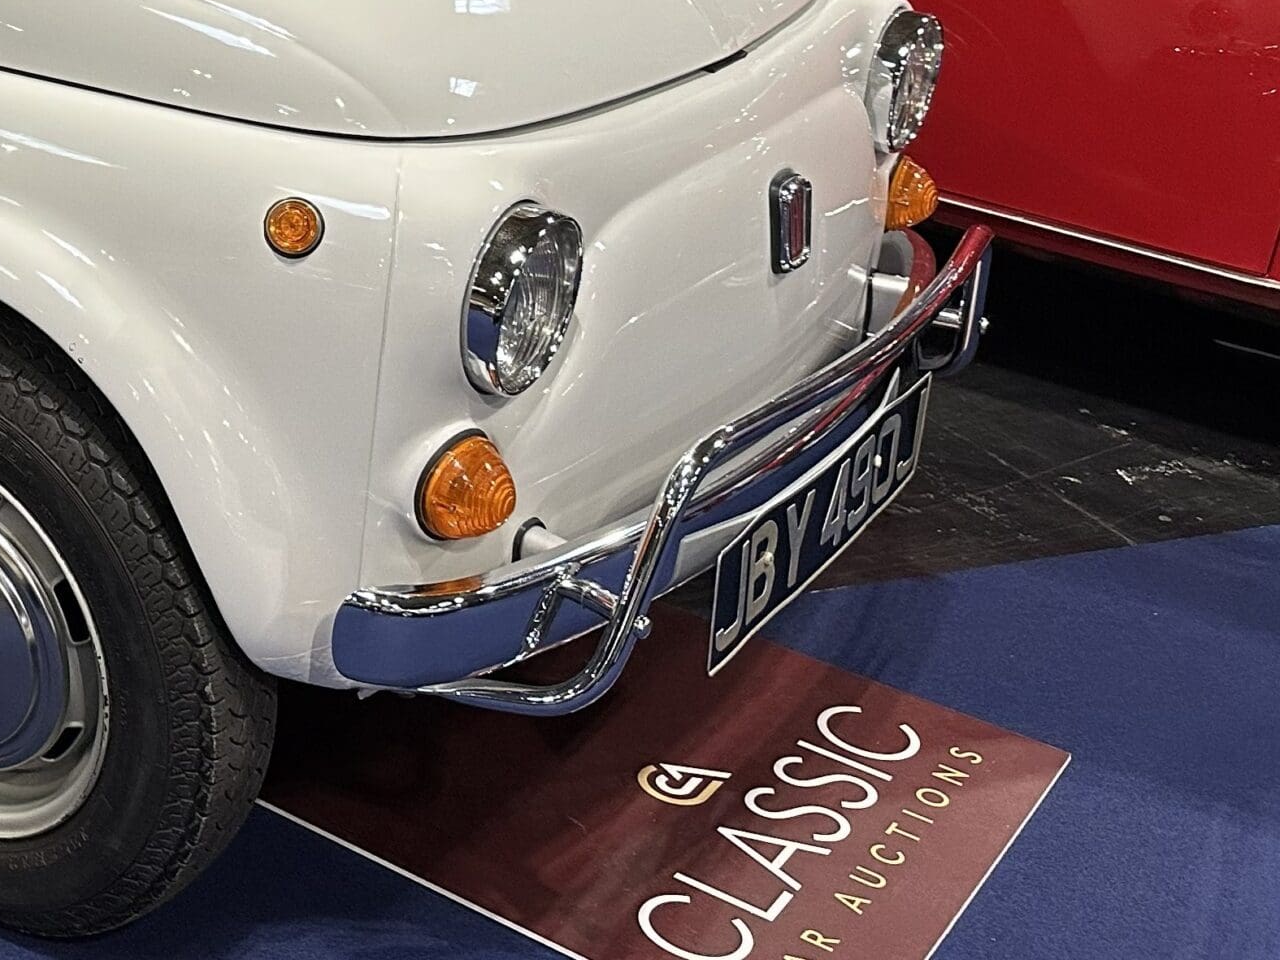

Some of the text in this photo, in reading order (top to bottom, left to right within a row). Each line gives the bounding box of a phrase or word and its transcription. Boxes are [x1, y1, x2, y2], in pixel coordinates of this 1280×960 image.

[715, 388, 930, 651] JBY 490J
[637, 706, 921, 960] CLASSIC
[834, 746, 983, 915] AUCTIONS
